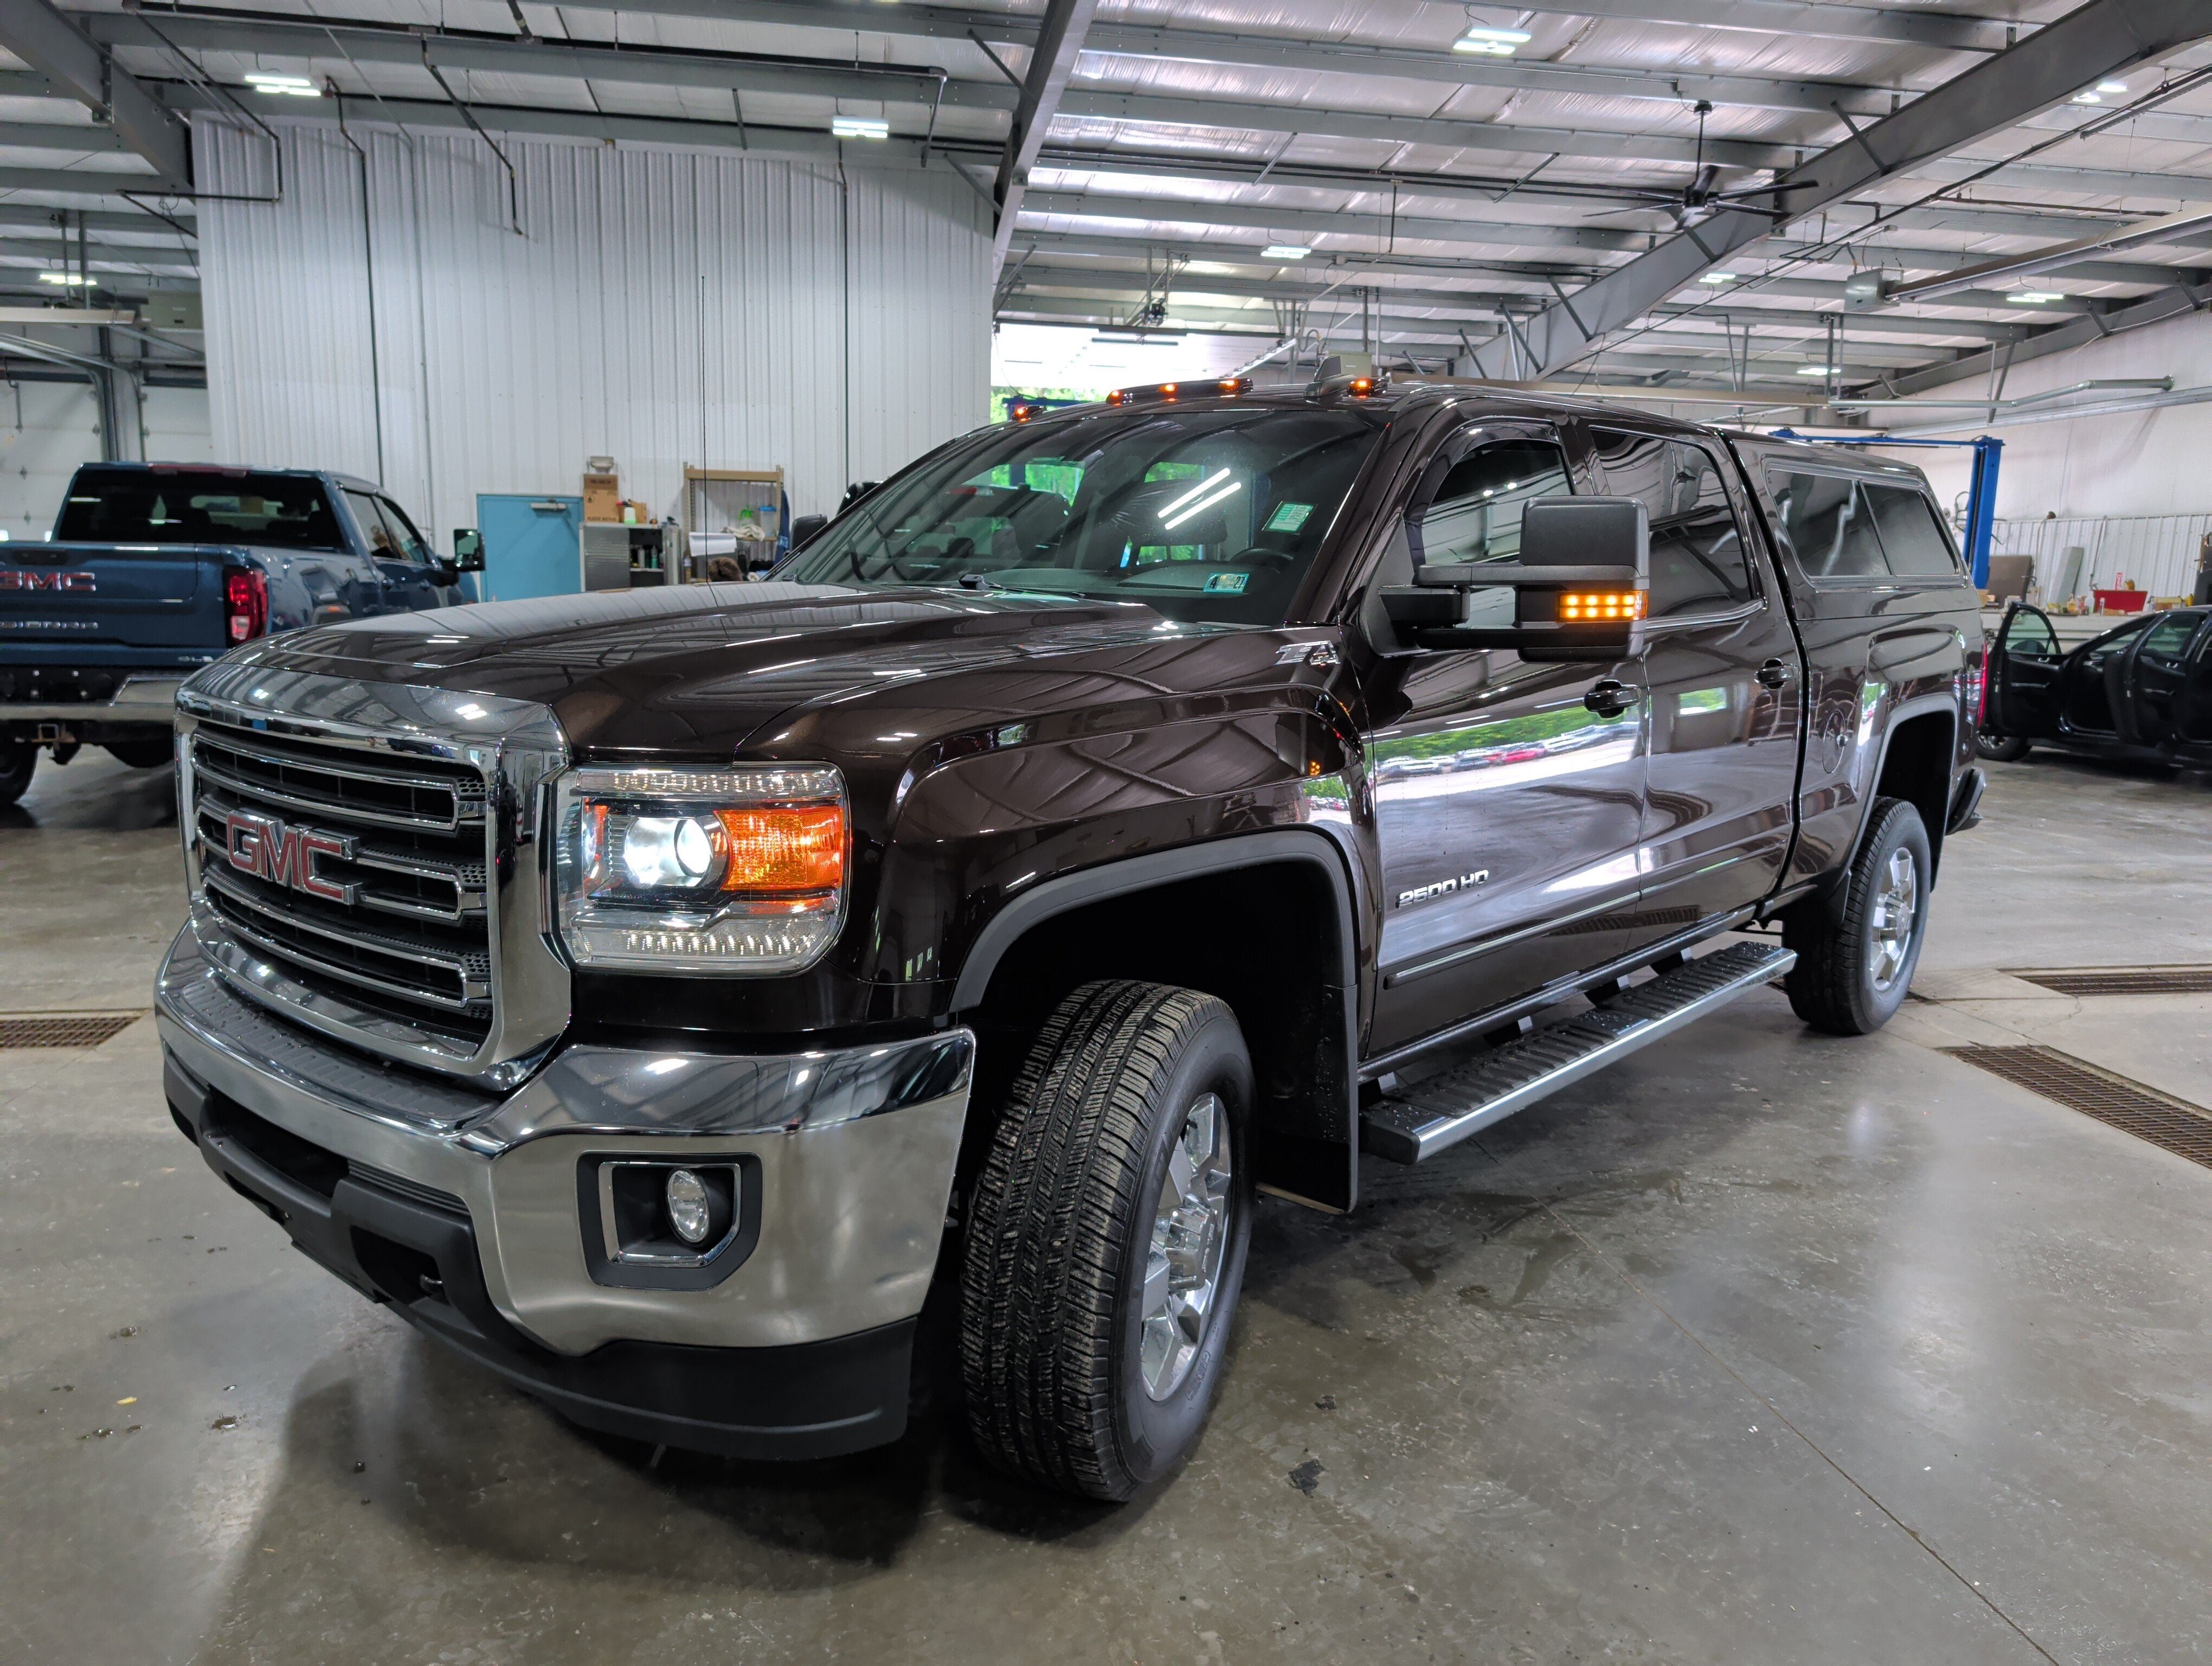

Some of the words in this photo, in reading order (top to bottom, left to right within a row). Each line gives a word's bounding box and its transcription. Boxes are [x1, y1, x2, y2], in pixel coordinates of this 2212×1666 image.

[1209, 576, 1219, 589] 4
[1233, 576, 1245, 589] 27
[227, 811, 356, 905] GMC
[1395, 879, 1457, 908] 2500
[1457, 869, 1489, 891] HD
